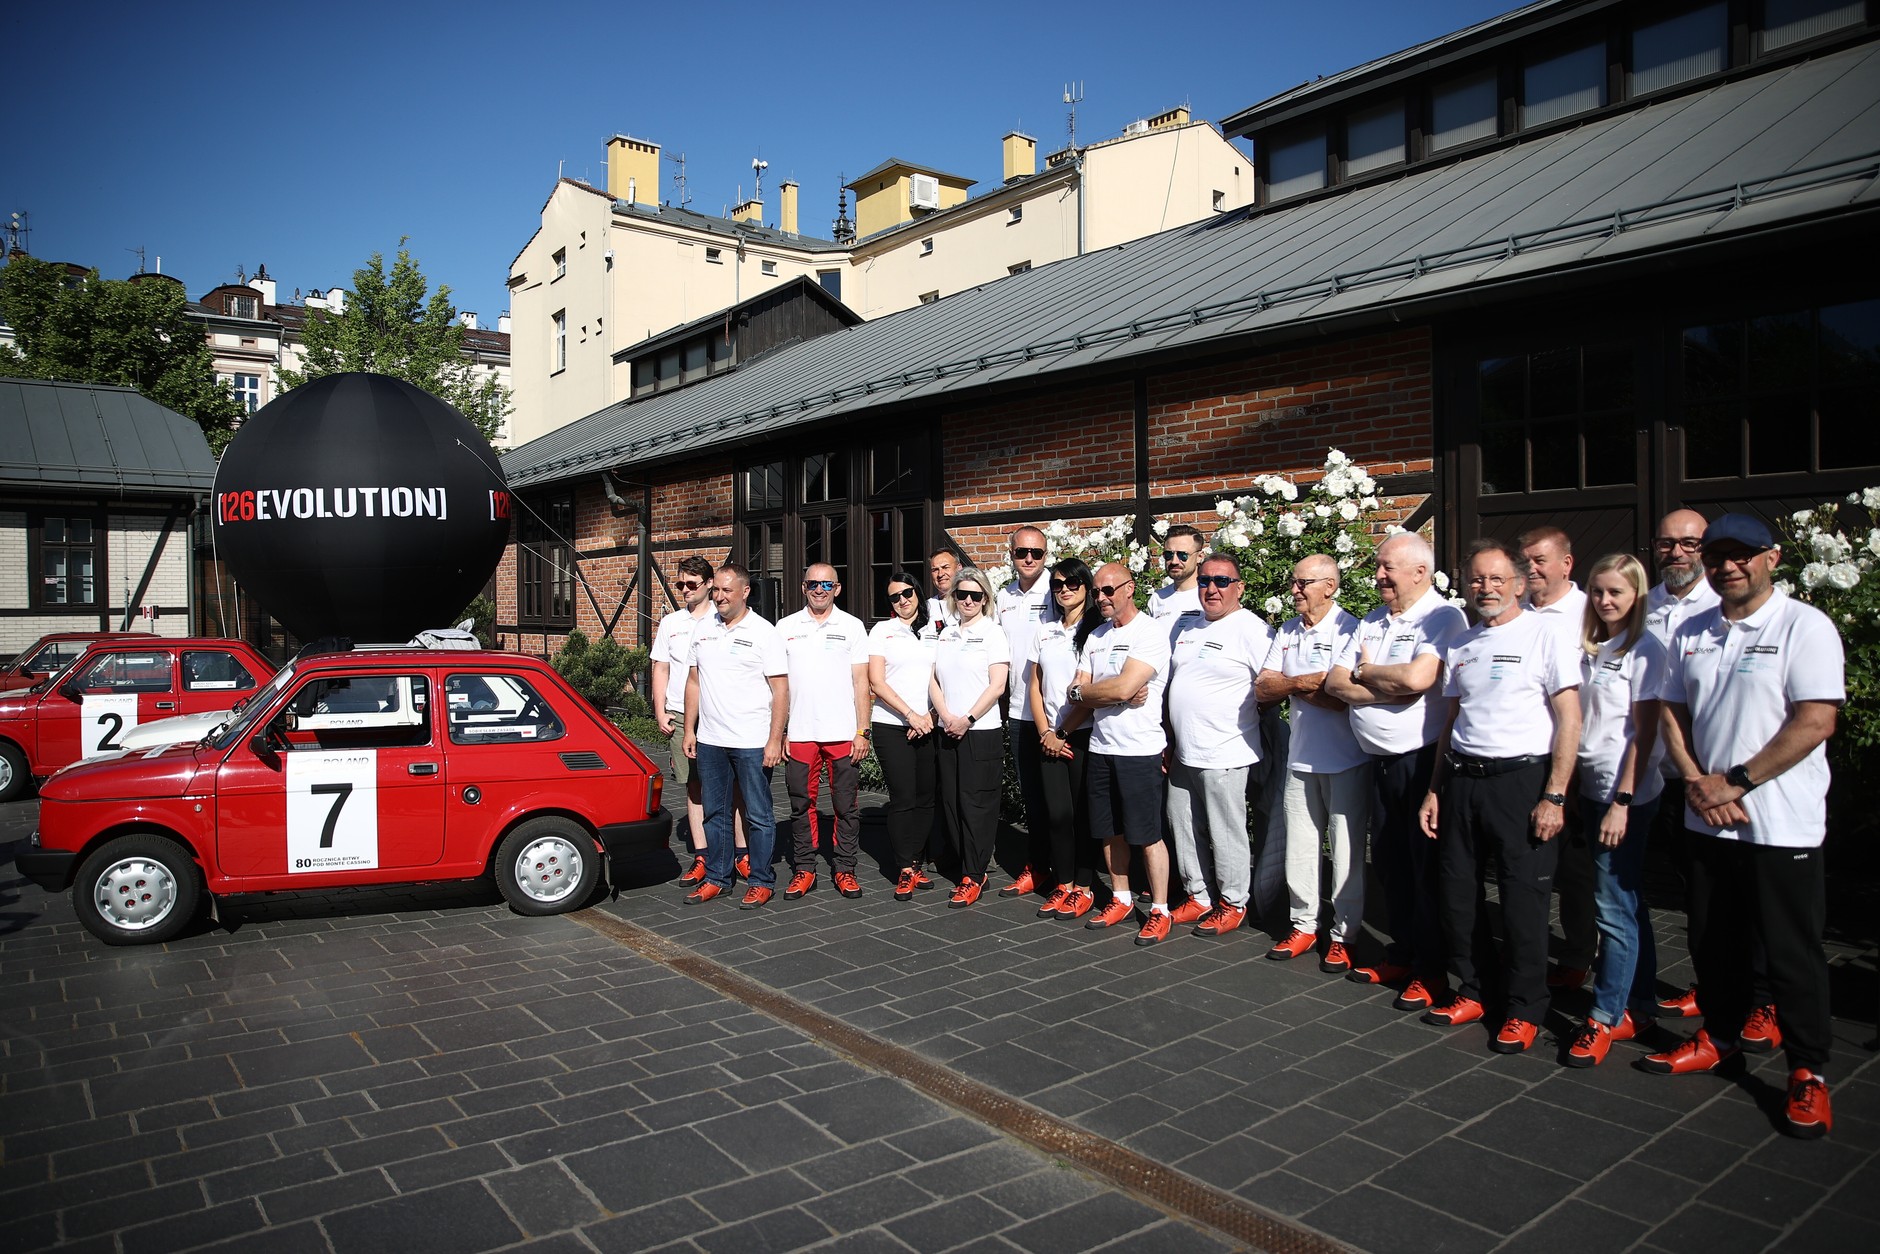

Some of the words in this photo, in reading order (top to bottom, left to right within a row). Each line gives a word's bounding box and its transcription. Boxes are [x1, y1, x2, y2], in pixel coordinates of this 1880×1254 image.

[97, 712, 123, 751] 2
[310, 783, 353, 849] 7
[295, 858, 312, 869] 80
